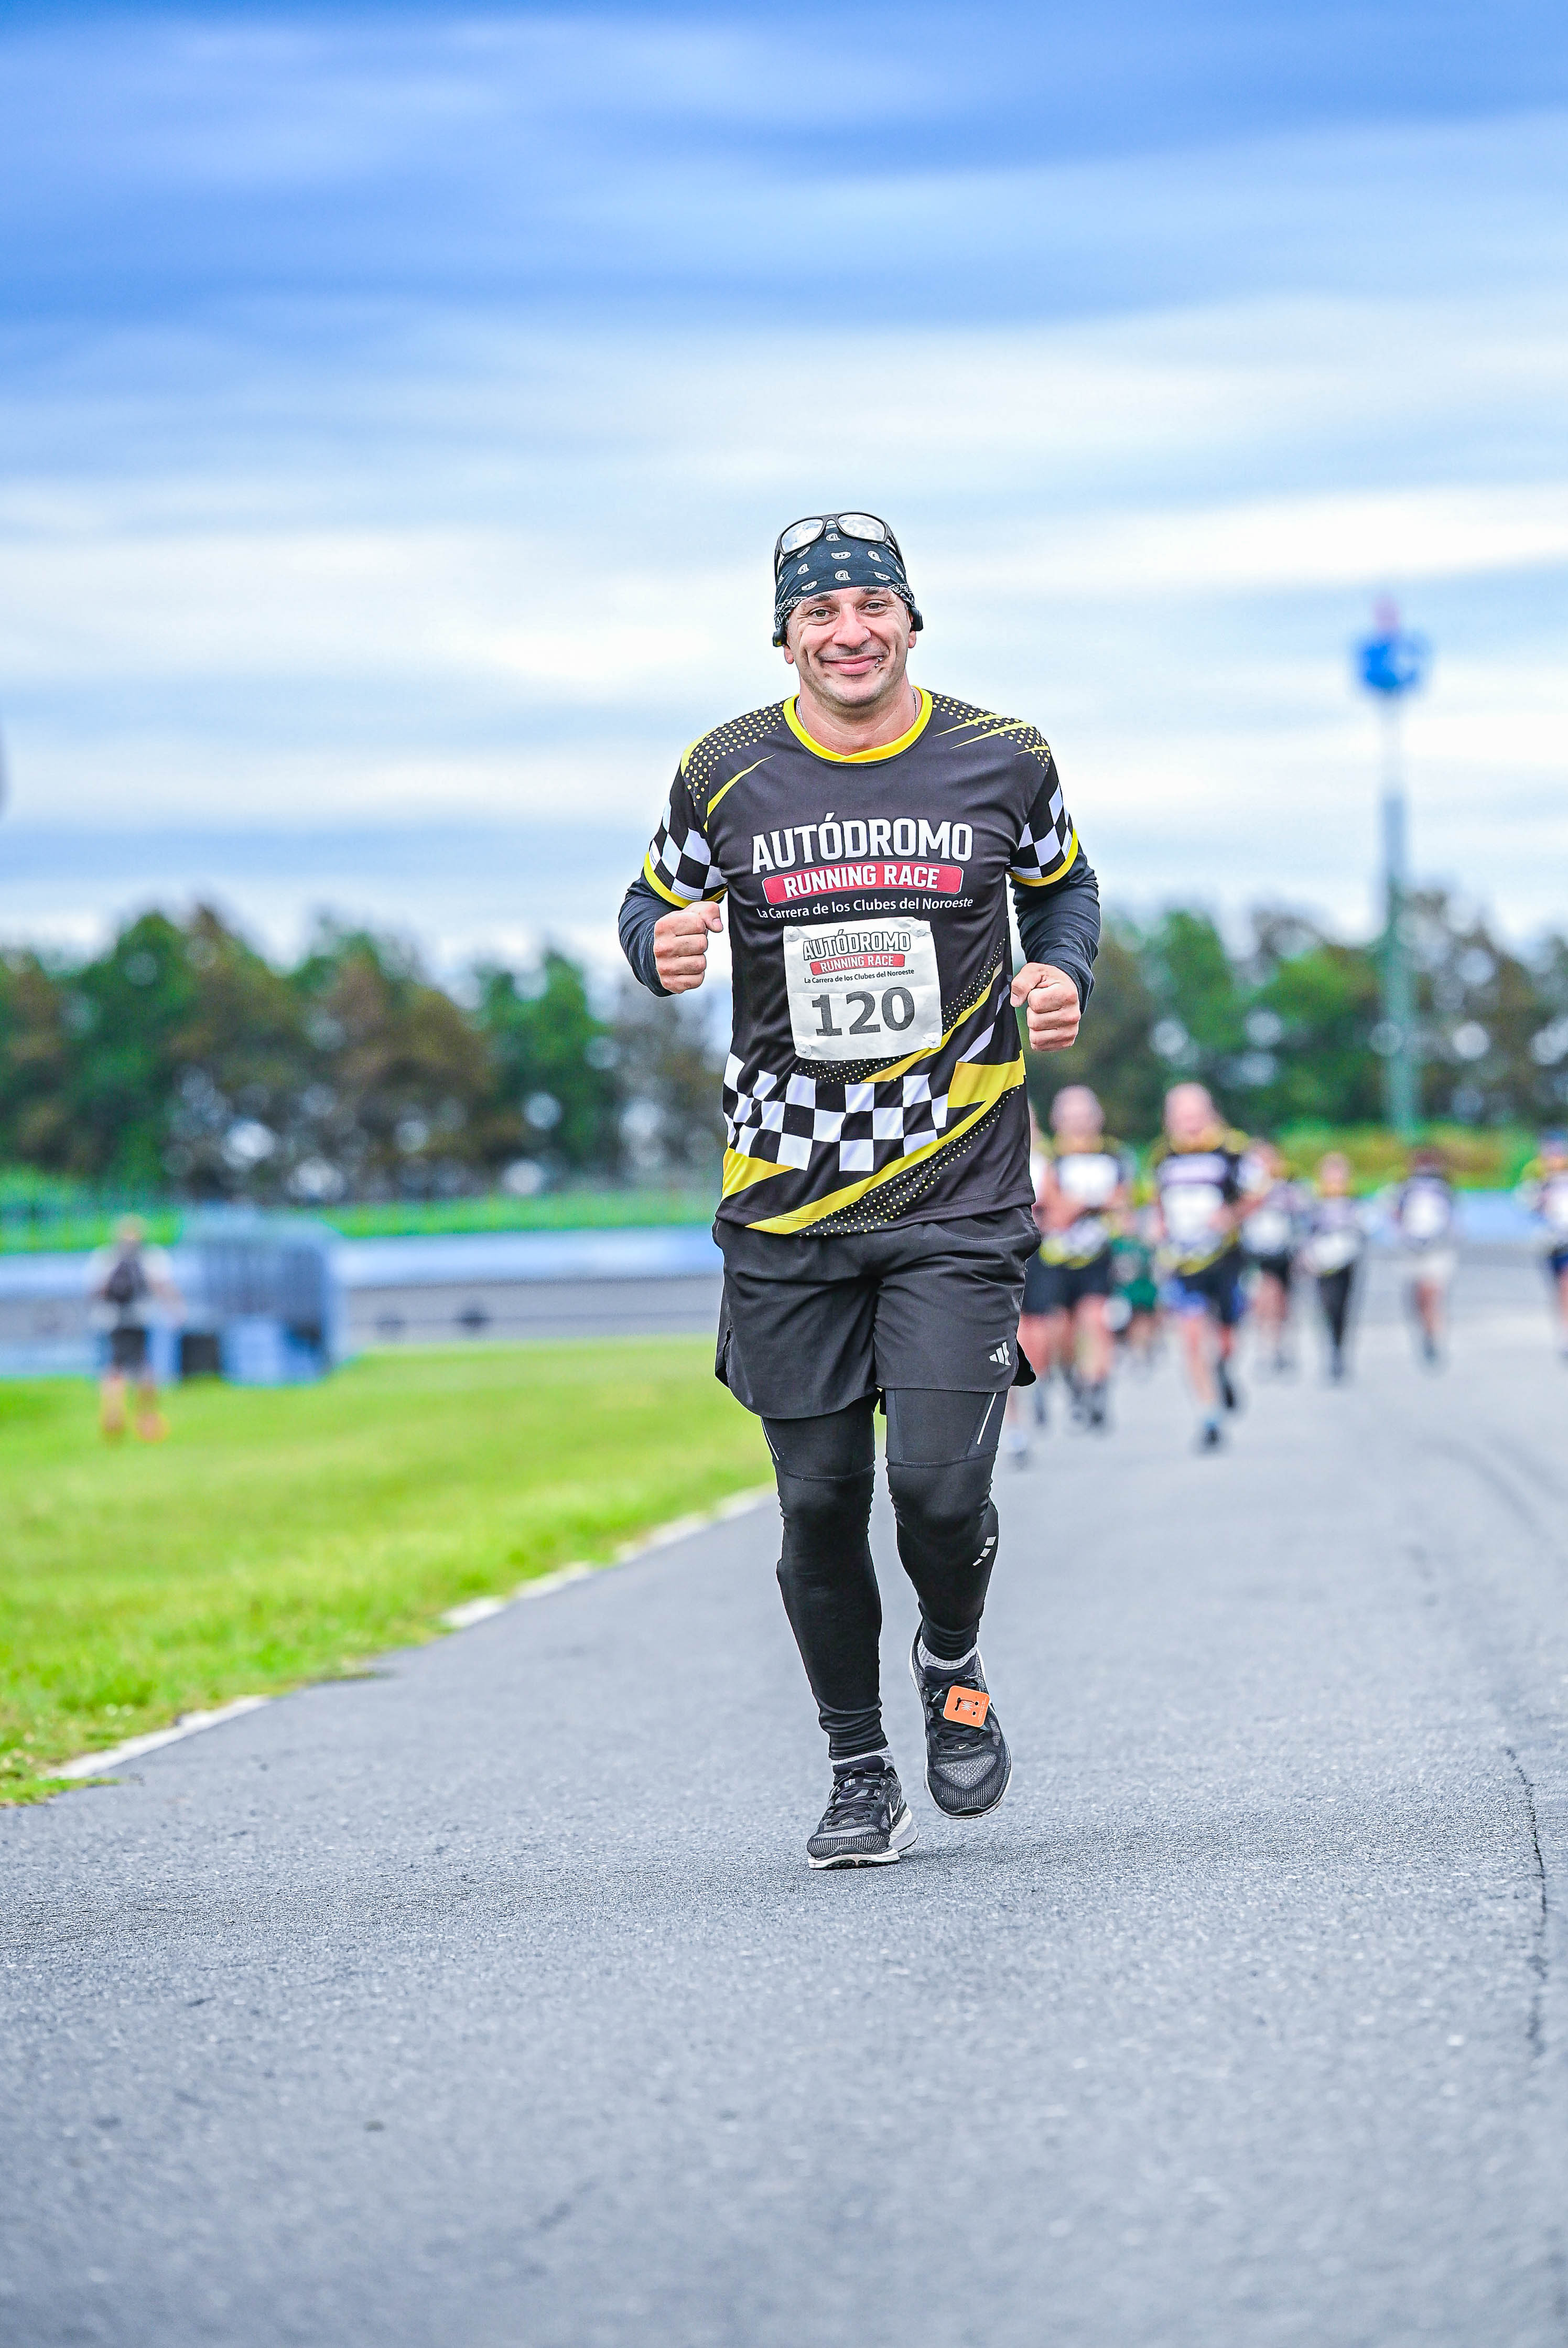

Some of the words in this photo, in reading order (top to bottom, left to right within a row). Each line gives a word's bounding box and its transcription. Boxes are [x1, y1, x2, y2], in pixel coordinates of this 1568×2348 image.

[752, 812, 974, 875] AUTÓDROMO
[783, 865, 877, 899] RUNNING
[883, 865, 940, 890] RACE
[756, 908, 769, 918] La
[769, 908, 810, 919] Carrera
[813, 902, 829, 915] de
[831, 901, 851, 913] los
[853, 898, 896, 911] Clubes
[899, 897, 920, 910] del
[922, 897, 974, 910] Noroeste
[803, 929, 911, 961] AUTÓDROMO
[819, 956, 864, 973] RUNNING
[868, 955, 894, 966] RACE
[887, 968, 915, 977] Noroeste
[812, 986, 915, 1037] 120
